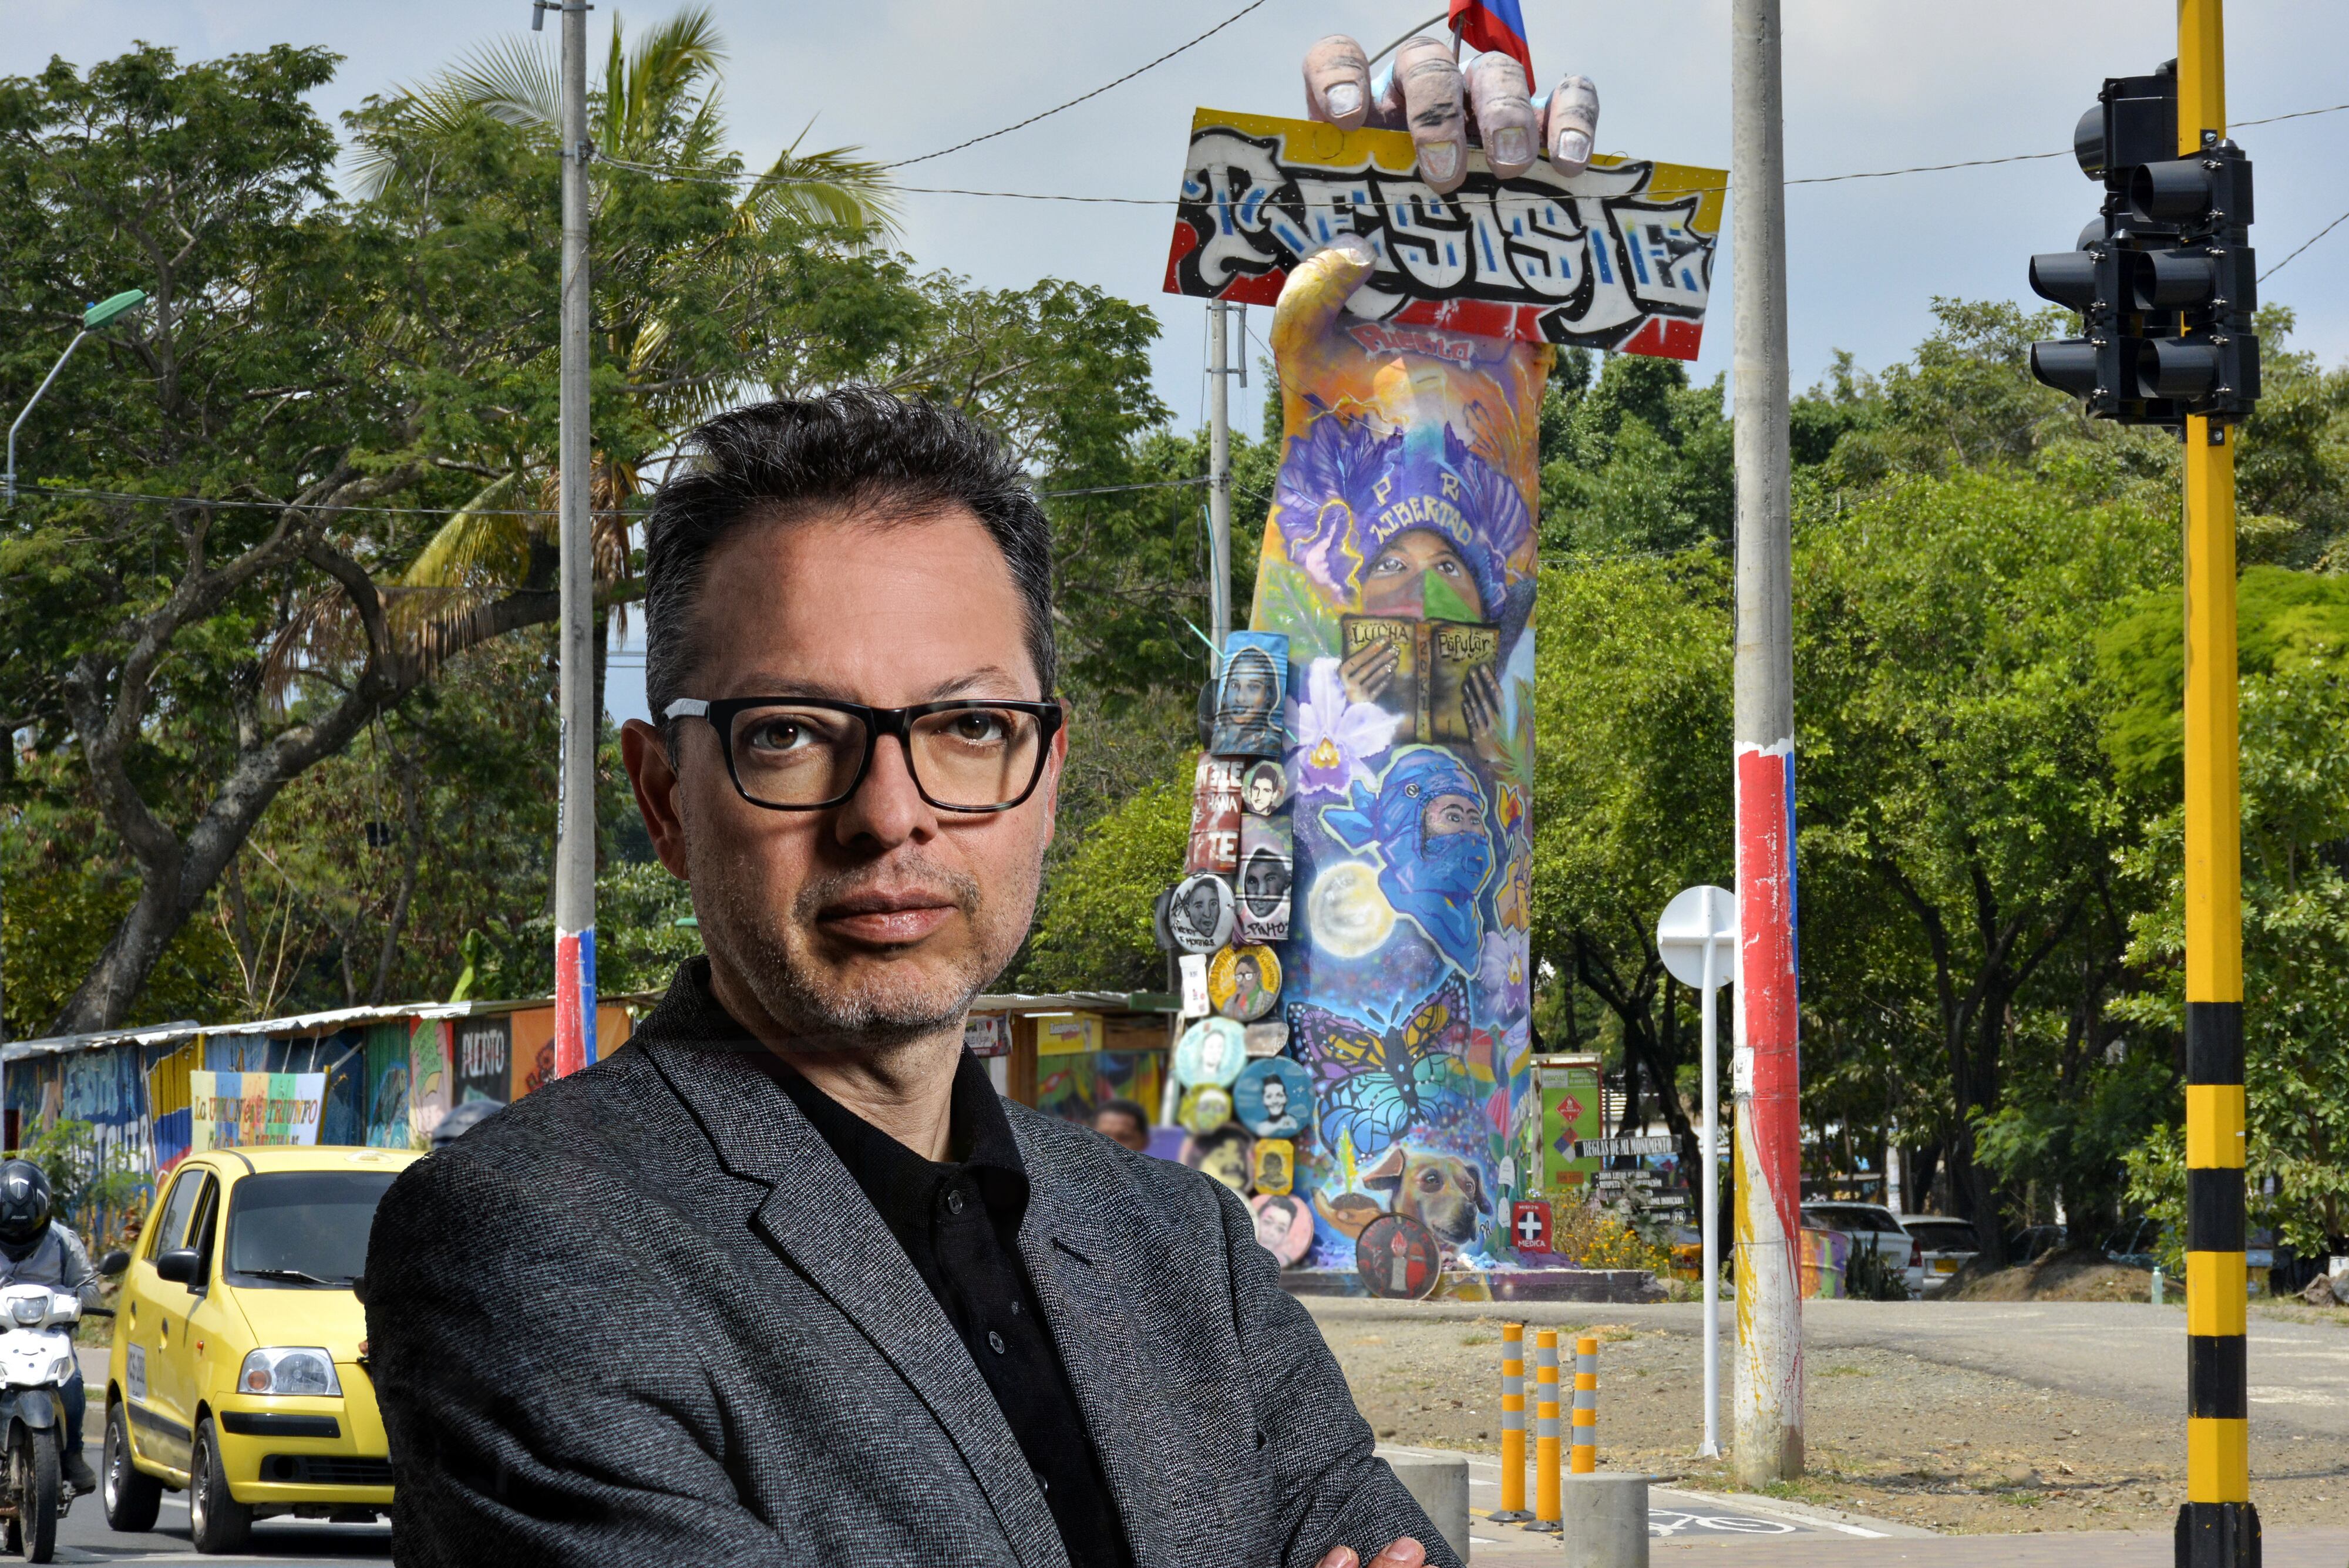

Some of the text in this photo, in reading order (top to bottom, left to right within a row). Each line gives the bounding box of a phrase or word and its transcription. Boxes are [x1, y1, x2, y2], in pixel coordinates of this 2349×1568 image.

[461, 1029, 504, 1078] PUERTO
[268, 1098, 318, 1124] TRIUNFO
[1583, 1136, 1672, 1157] REGLAS DE MI MONUMENTO
